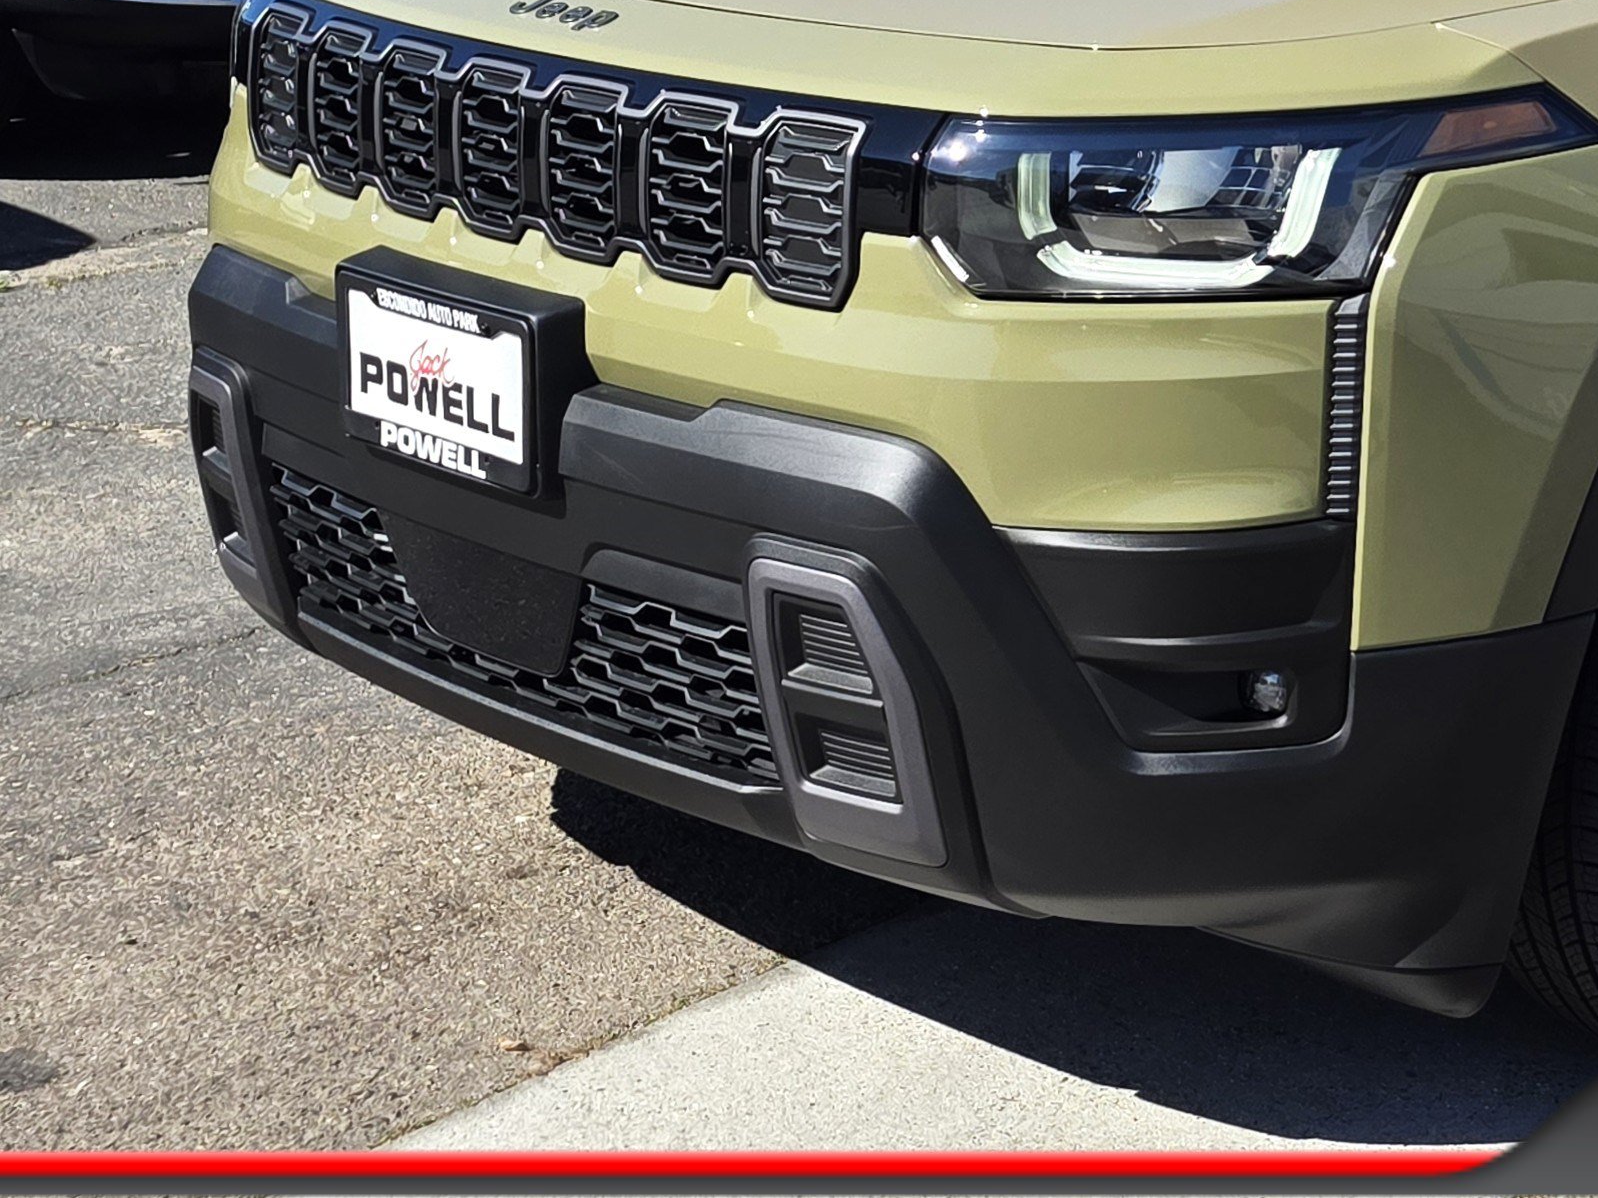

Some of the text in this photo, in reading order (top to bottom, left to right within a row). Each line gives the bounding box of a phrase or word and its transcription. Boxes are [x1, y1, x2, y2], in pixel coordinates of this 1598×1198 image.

[427, 302, 453, 327] AUTO
[452, 308, 480, 334] PARK
[409, 339, 455, 394] Jack
[359, 351, 516, 442] POWELL
[379, 420, 487, 480] POWELL
